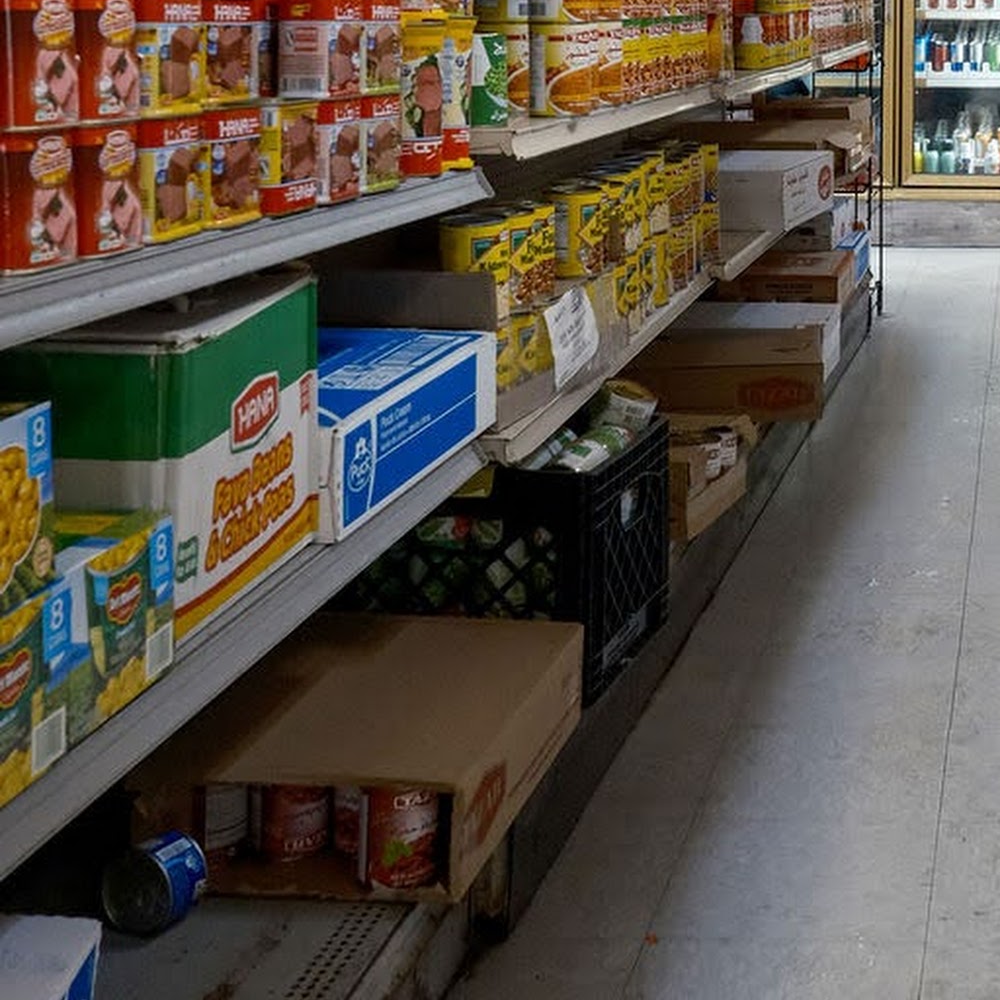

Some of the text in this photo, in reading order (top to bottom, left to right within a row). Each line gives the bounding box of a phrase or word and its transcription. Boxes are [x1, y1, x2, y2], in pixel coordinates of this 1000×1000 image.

[238, 384, 275, 434] HANA
[33, 416, 45, 446] 8
[212, 431, 294, 524] Fava Beans
[155, 533, 168, 560] 8
[51, 599, 64, 628] 8
